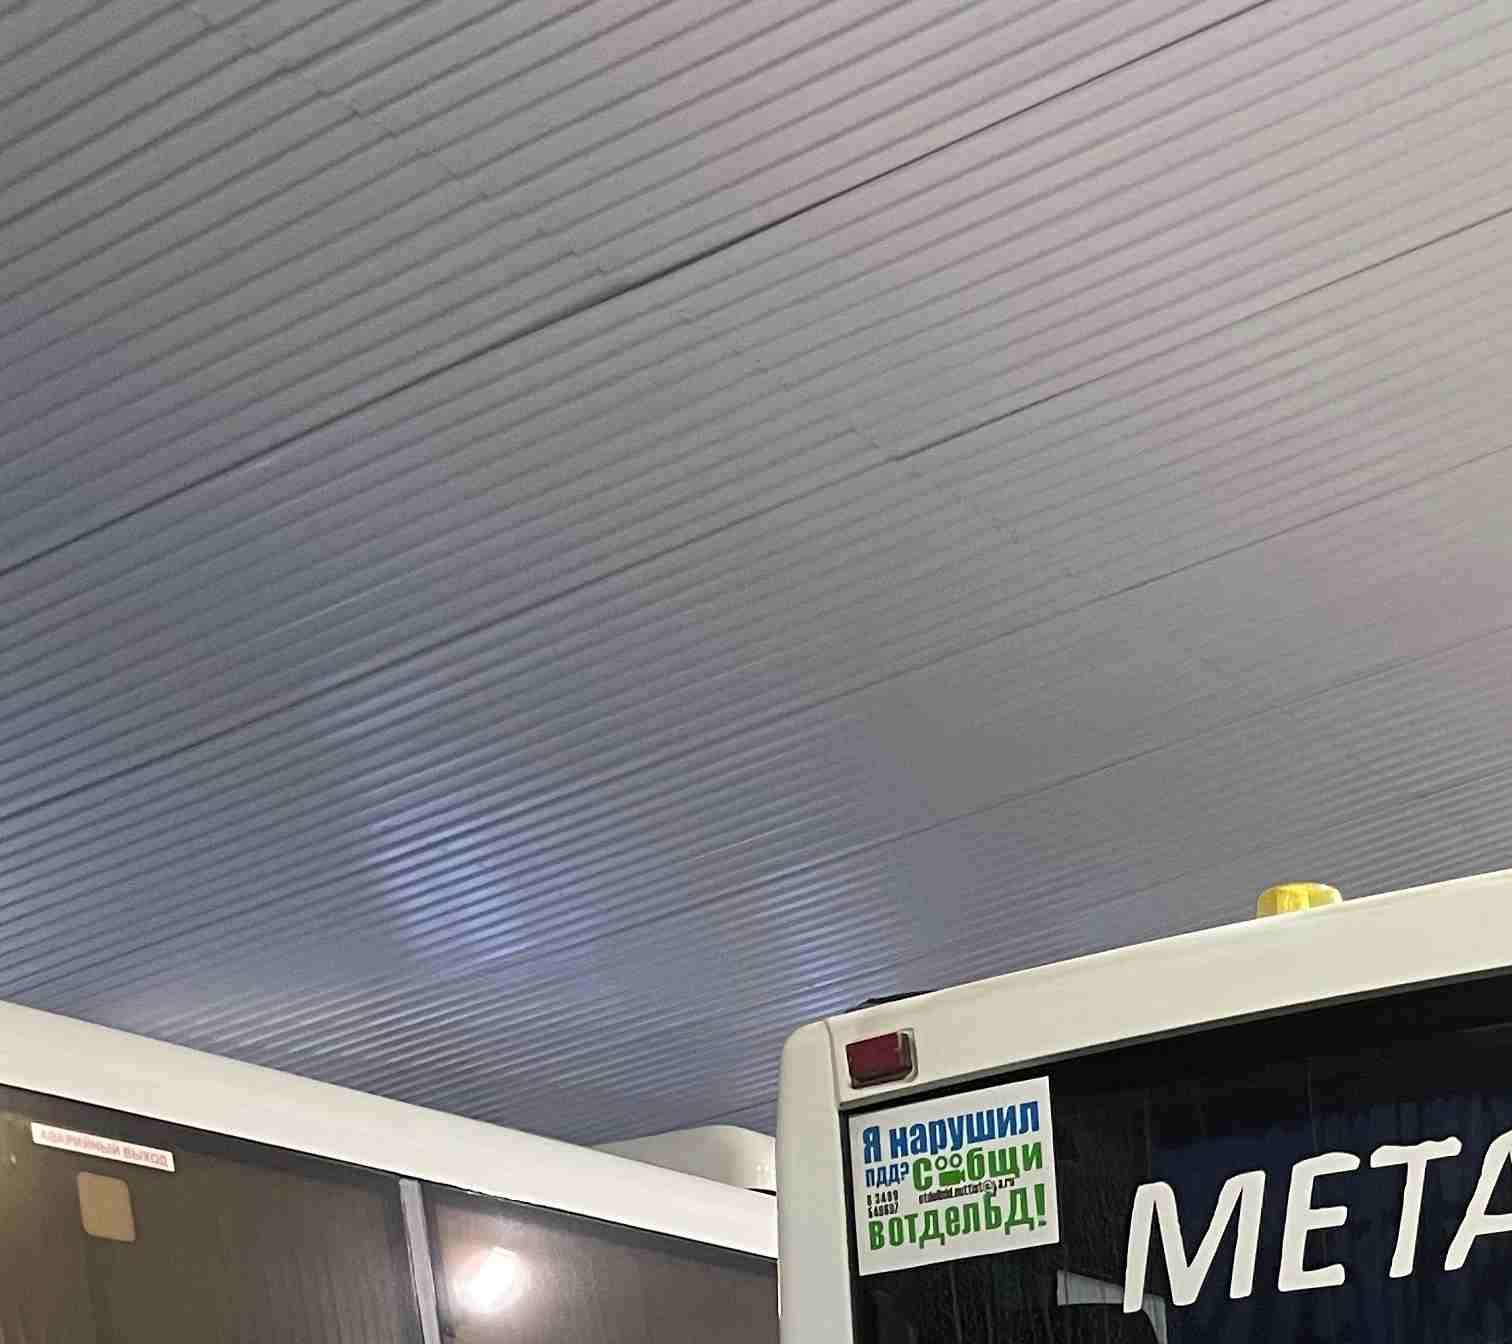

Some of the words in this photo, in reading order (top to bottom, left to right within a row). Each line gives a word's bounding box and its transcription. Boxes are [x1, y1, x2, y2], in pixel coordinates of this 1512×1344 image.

[863, 1125, 882, 1164] Я
[888, 1101, 1041, 1159] нарушил
[865, 1161, 910, 1189] ПДД?
